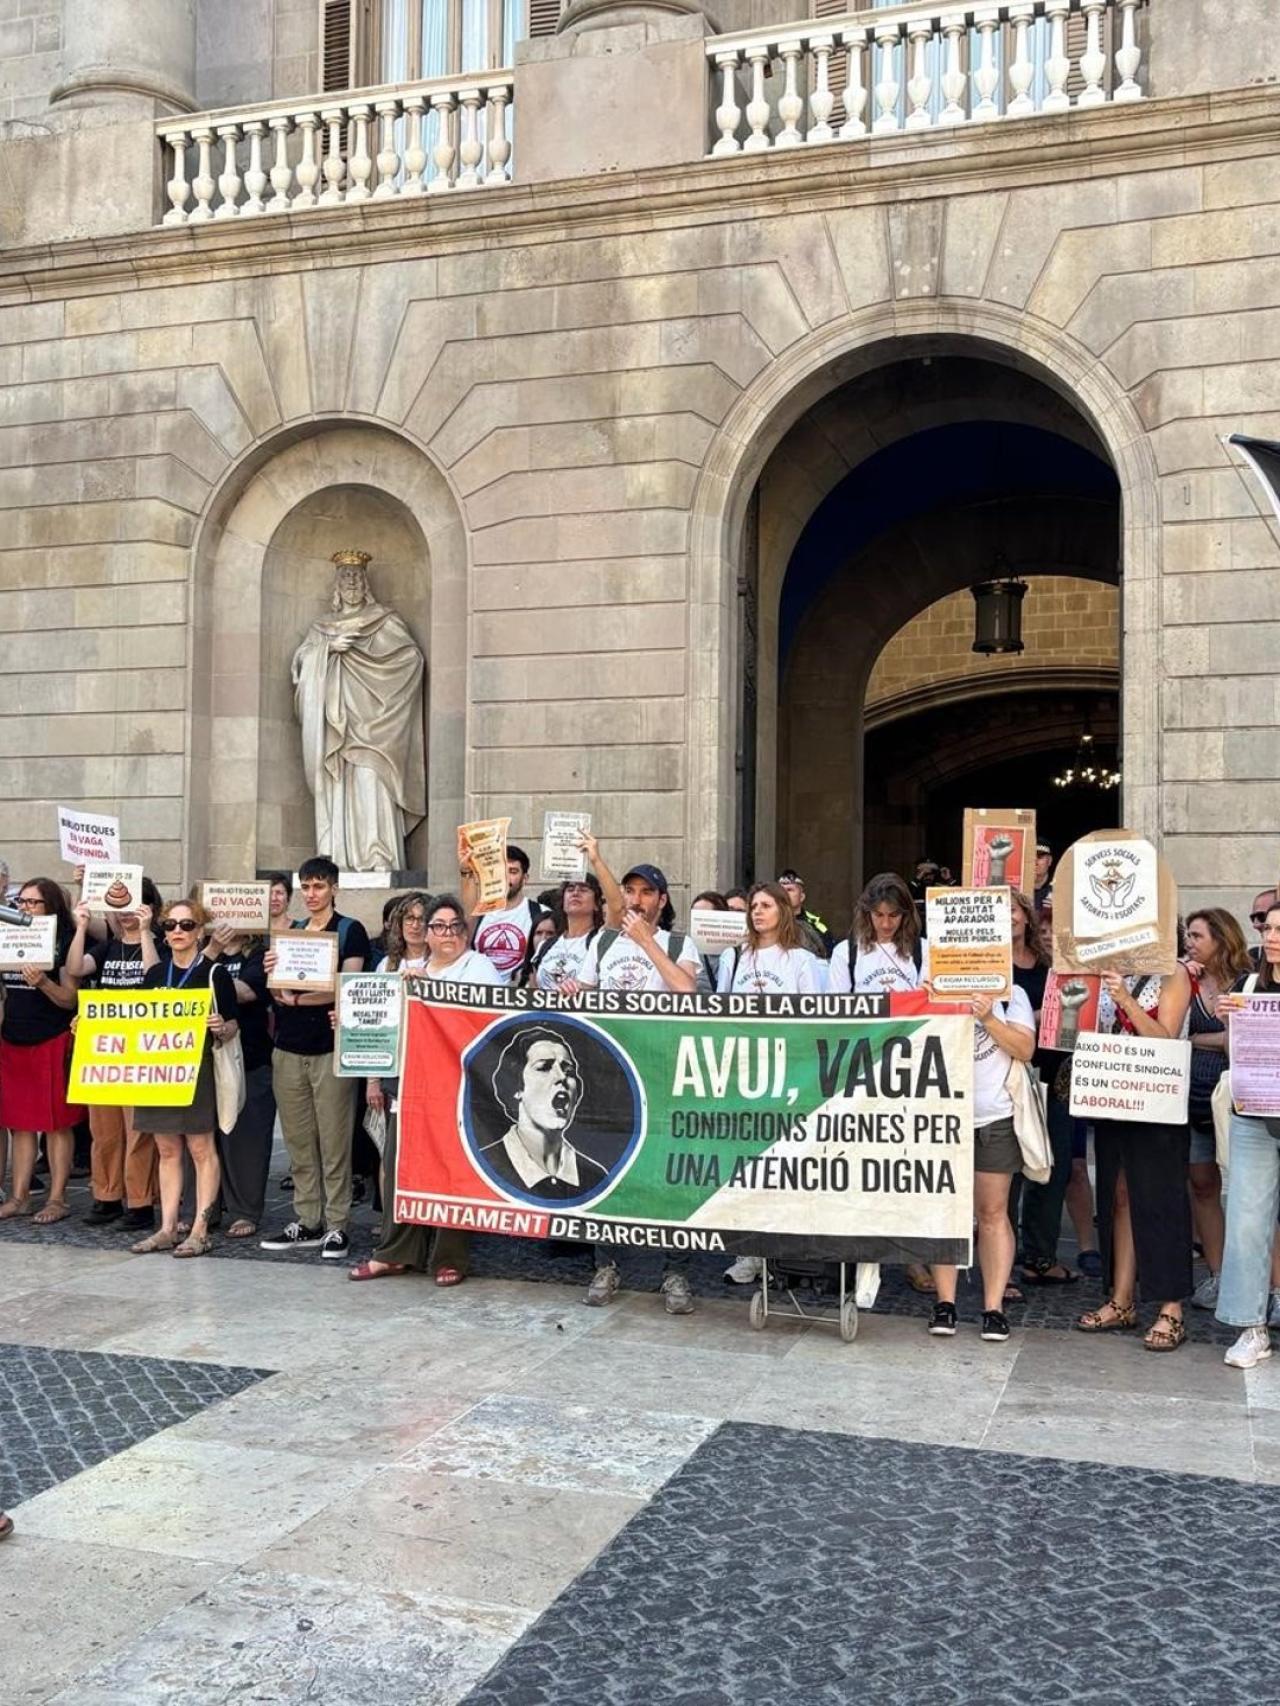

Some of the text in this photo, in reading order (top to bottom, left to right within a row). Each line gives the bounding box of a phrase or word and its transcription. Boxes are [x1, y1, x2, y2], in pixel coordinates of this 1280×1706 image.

[79, 836, 104, 846] VAGA
[209, 887, 265, 895] BIBLIOTEQUES
[211, 897, 262, 906] EN VAGA
[936, 896, 1003, 905] MILIONS PER A
[944, 905, 994, 914] LA CIUTAT
[944, 915, 995, 924] APARADOR
[87, 1001, 205, 1019] BIBLIOTEQUES
[492, 987, 527, 1007] ELS
[532, 989, 619, 1011] SERVEIS
[626, 993, 722, 1014] SOCIALS
[729, 994, 757, 1014] DE
[766, 995, 794, 1014] LA
[799, 995, 884, 1015] CIUTAT
[96, 1031, 195, 1053] EN VAGA
[1102, 1043, 1122, 1054] NO
[1140, 1046, 1155, 1057] UN
[671, 1035, 964, 1106] AVUI, VAGA.
[1074, 1059, 1183, 1077] CONFLICTE SINDICAL
[1075, 1075, 1179, 1095] ÉS UN CONFLICTE
[1073, 1095, 1145, 1111] LABORAL!!!
[671, 1110, 961, 1144] CONDICIONS DIGNES PER
[665, 1151, 955, 1194] UNA ATENCIÓ DIGNA
[398, 1199, 725, 1251] AJUNTAMENT DE BARCELONA
